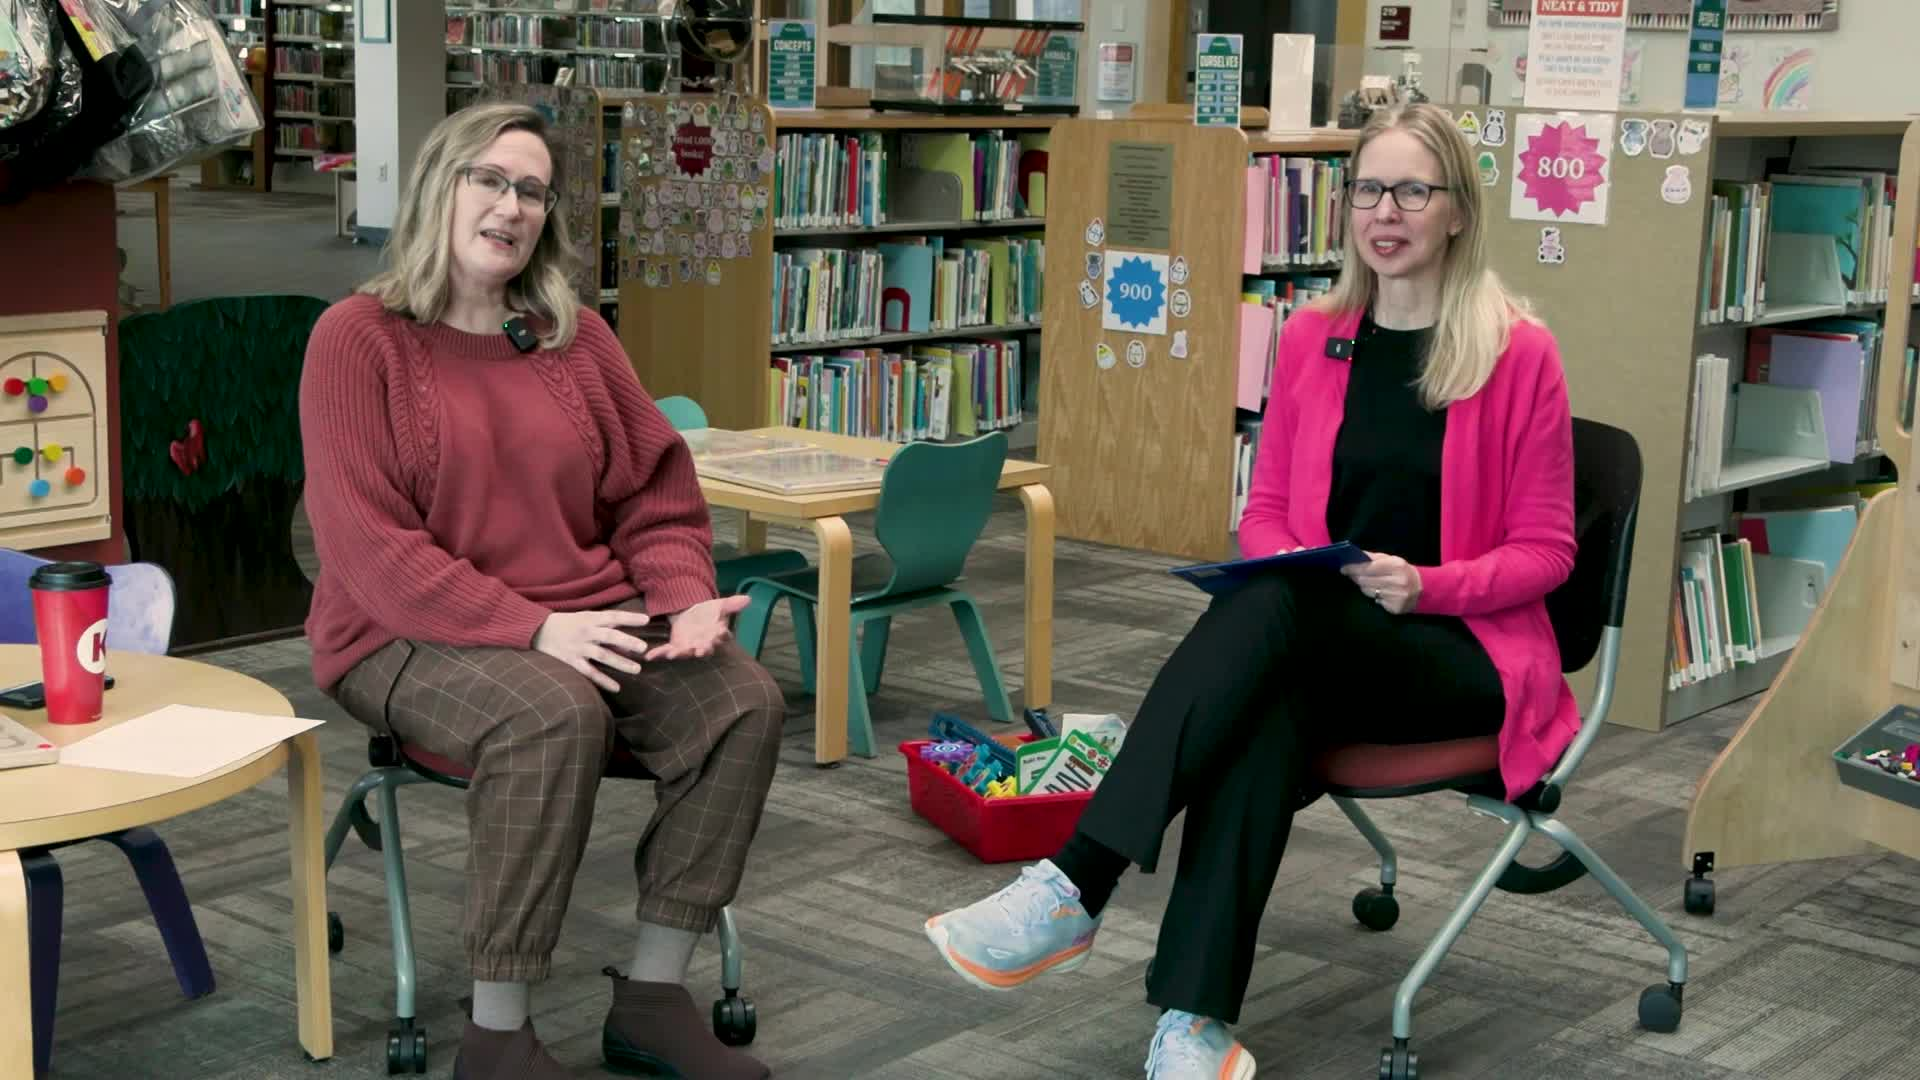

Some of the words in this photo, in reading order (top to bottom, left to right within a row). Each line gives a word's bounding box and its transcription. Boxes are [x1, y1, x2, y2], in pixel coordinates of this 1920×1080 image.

[1541, 1, 1575, 11] NEAT
[1577, 2, 1585, 12] &
[1588, 1, 1619, 13] TIDY
[773, 40, 812, 52] CONCEPTS
[1199, 55, 1239, 68] OURSELVES
[1537, 156, 1585, 179] 800
[1119, 282, 1152, 301] 900
